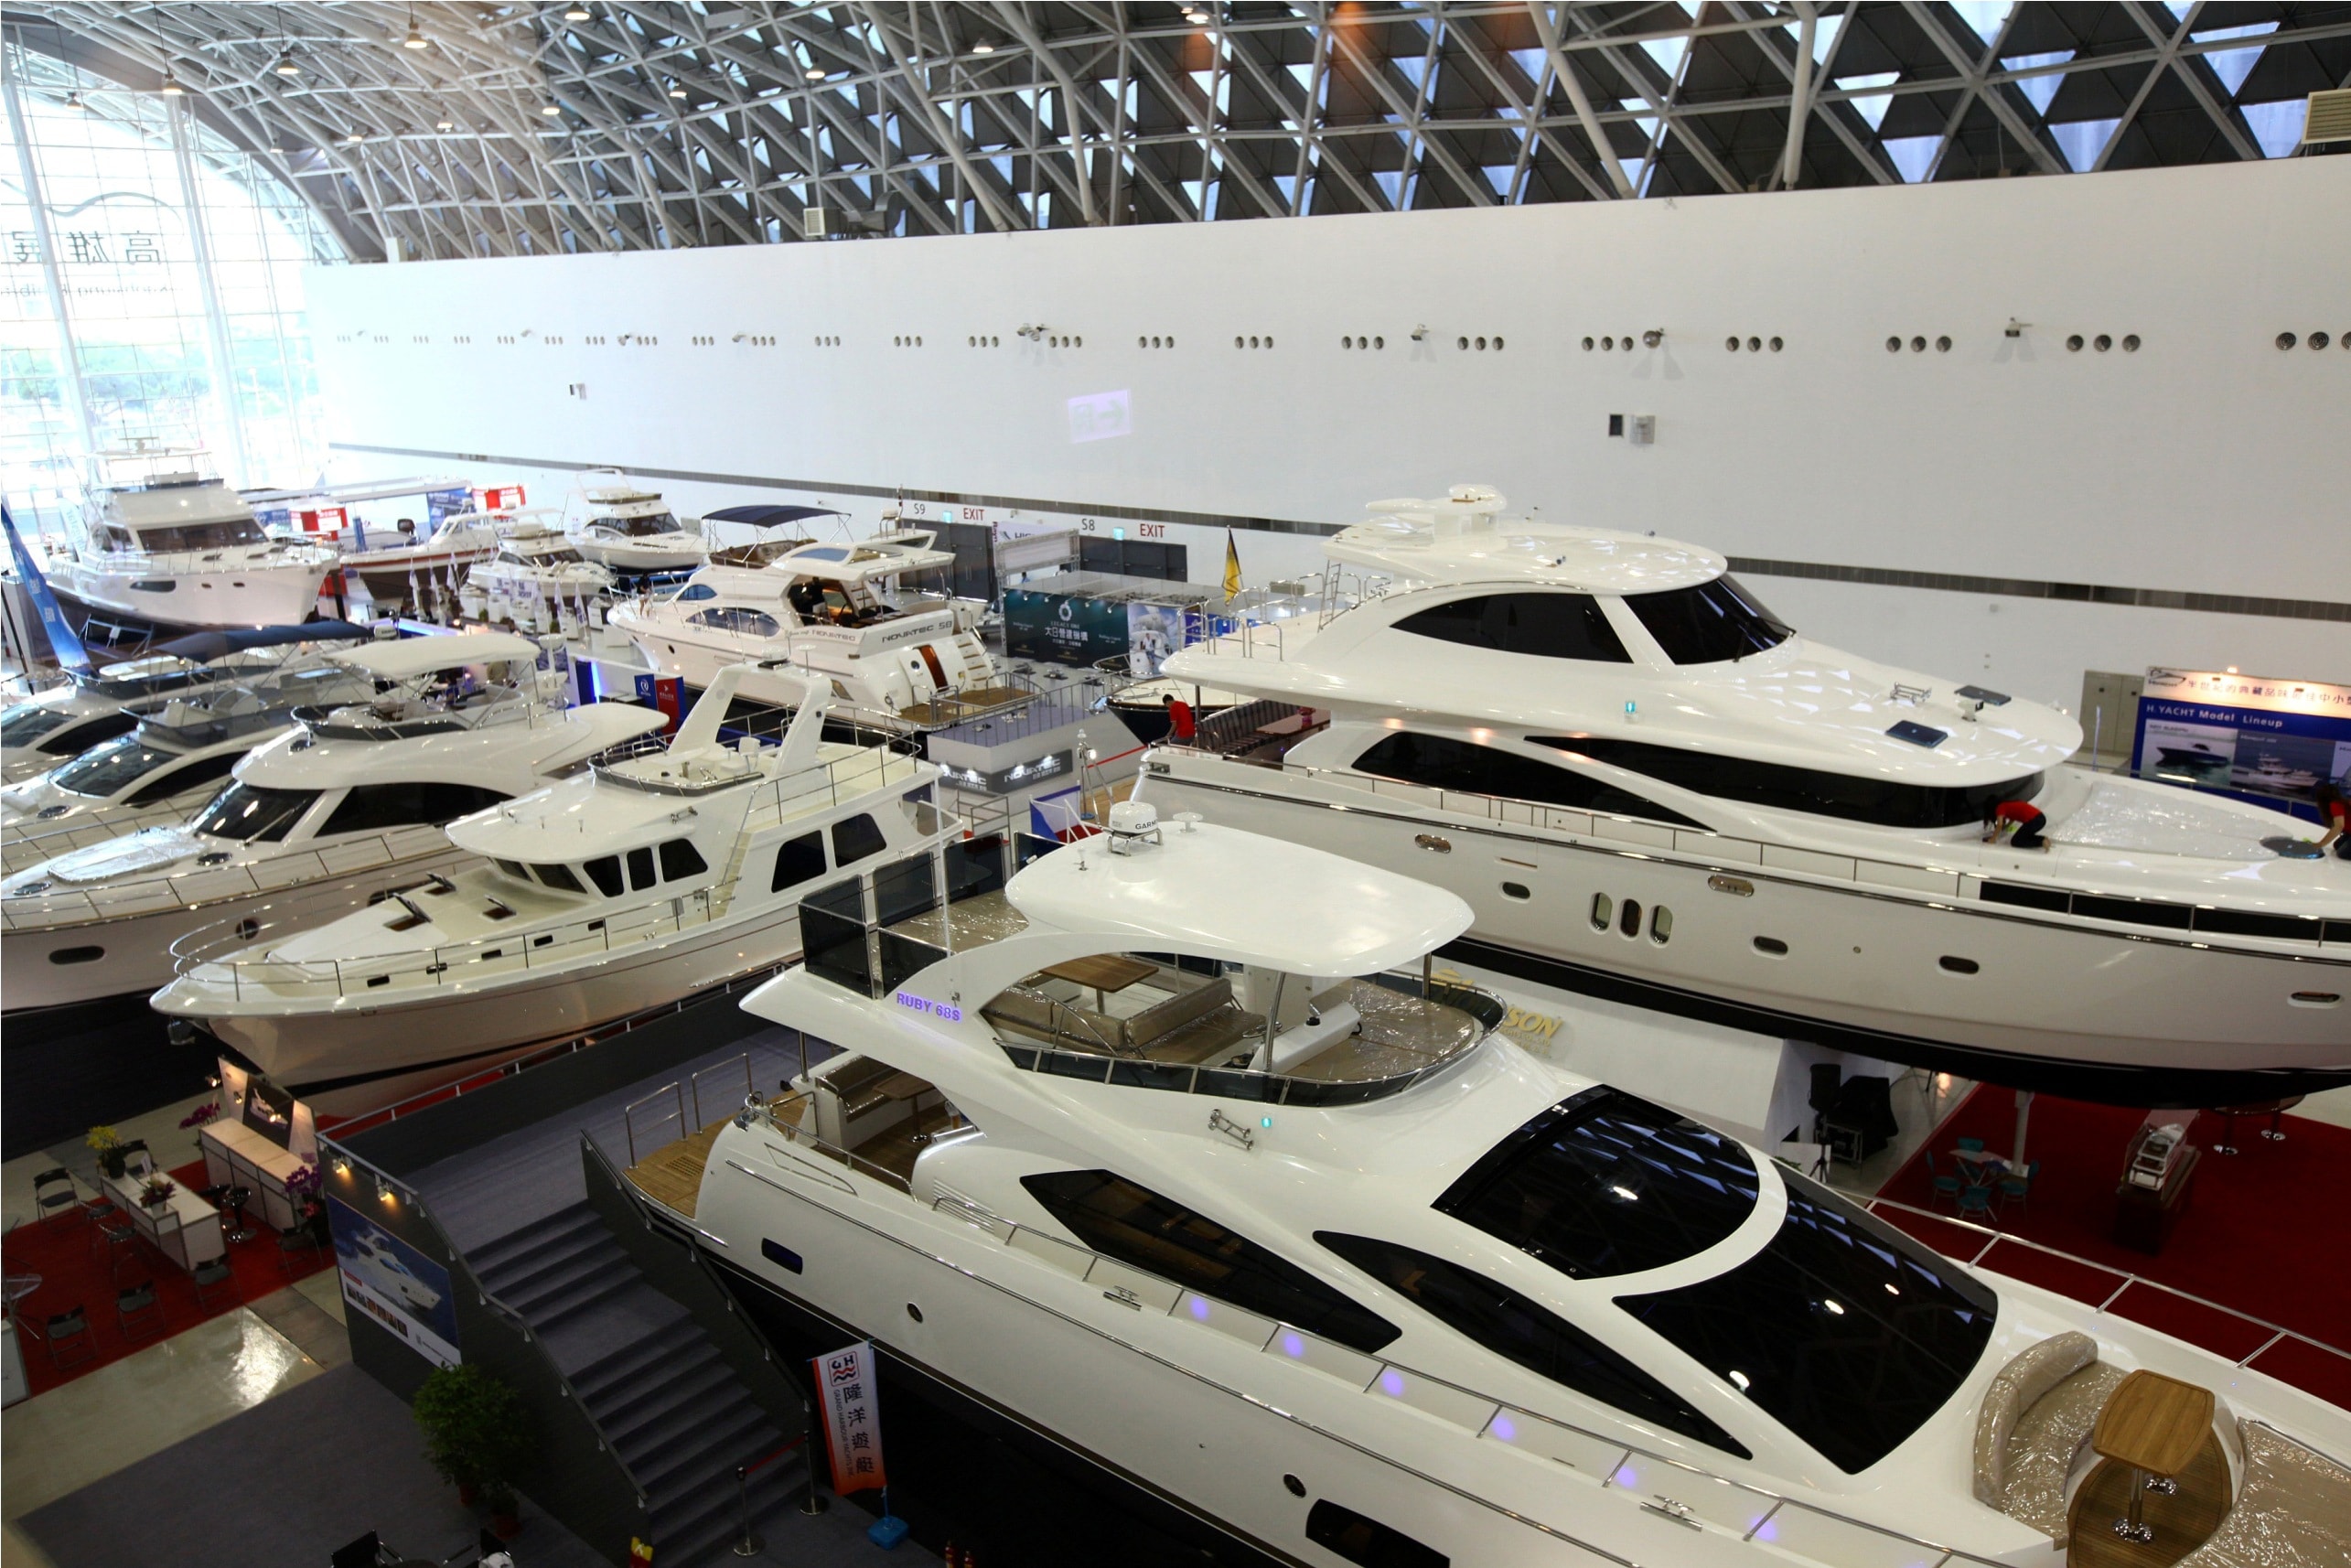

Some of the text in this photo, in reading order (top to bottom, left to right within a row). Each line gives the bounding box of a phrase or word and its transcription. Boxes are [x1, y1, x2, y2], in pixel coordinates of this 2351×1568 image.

[914, 503, 926, 515] S9
[962, 508, 985, 521] EXIT
[1081, 518, 1095, 532] S8
[1140, 523, 1165, 538] EXIT
[882, 620, 953, 643] NOVATEC 58
[2159, 705, 2195, 717] YACHT
[2198, 710, 2235, 722] Model
[2243, 714, 2283, 729] Lineup
[896, 993, 961, 1022] RUBY 68S
[833, 1389, 843, 1412] GRAND
[838, 1412, 848, 1442] HARBOUR
